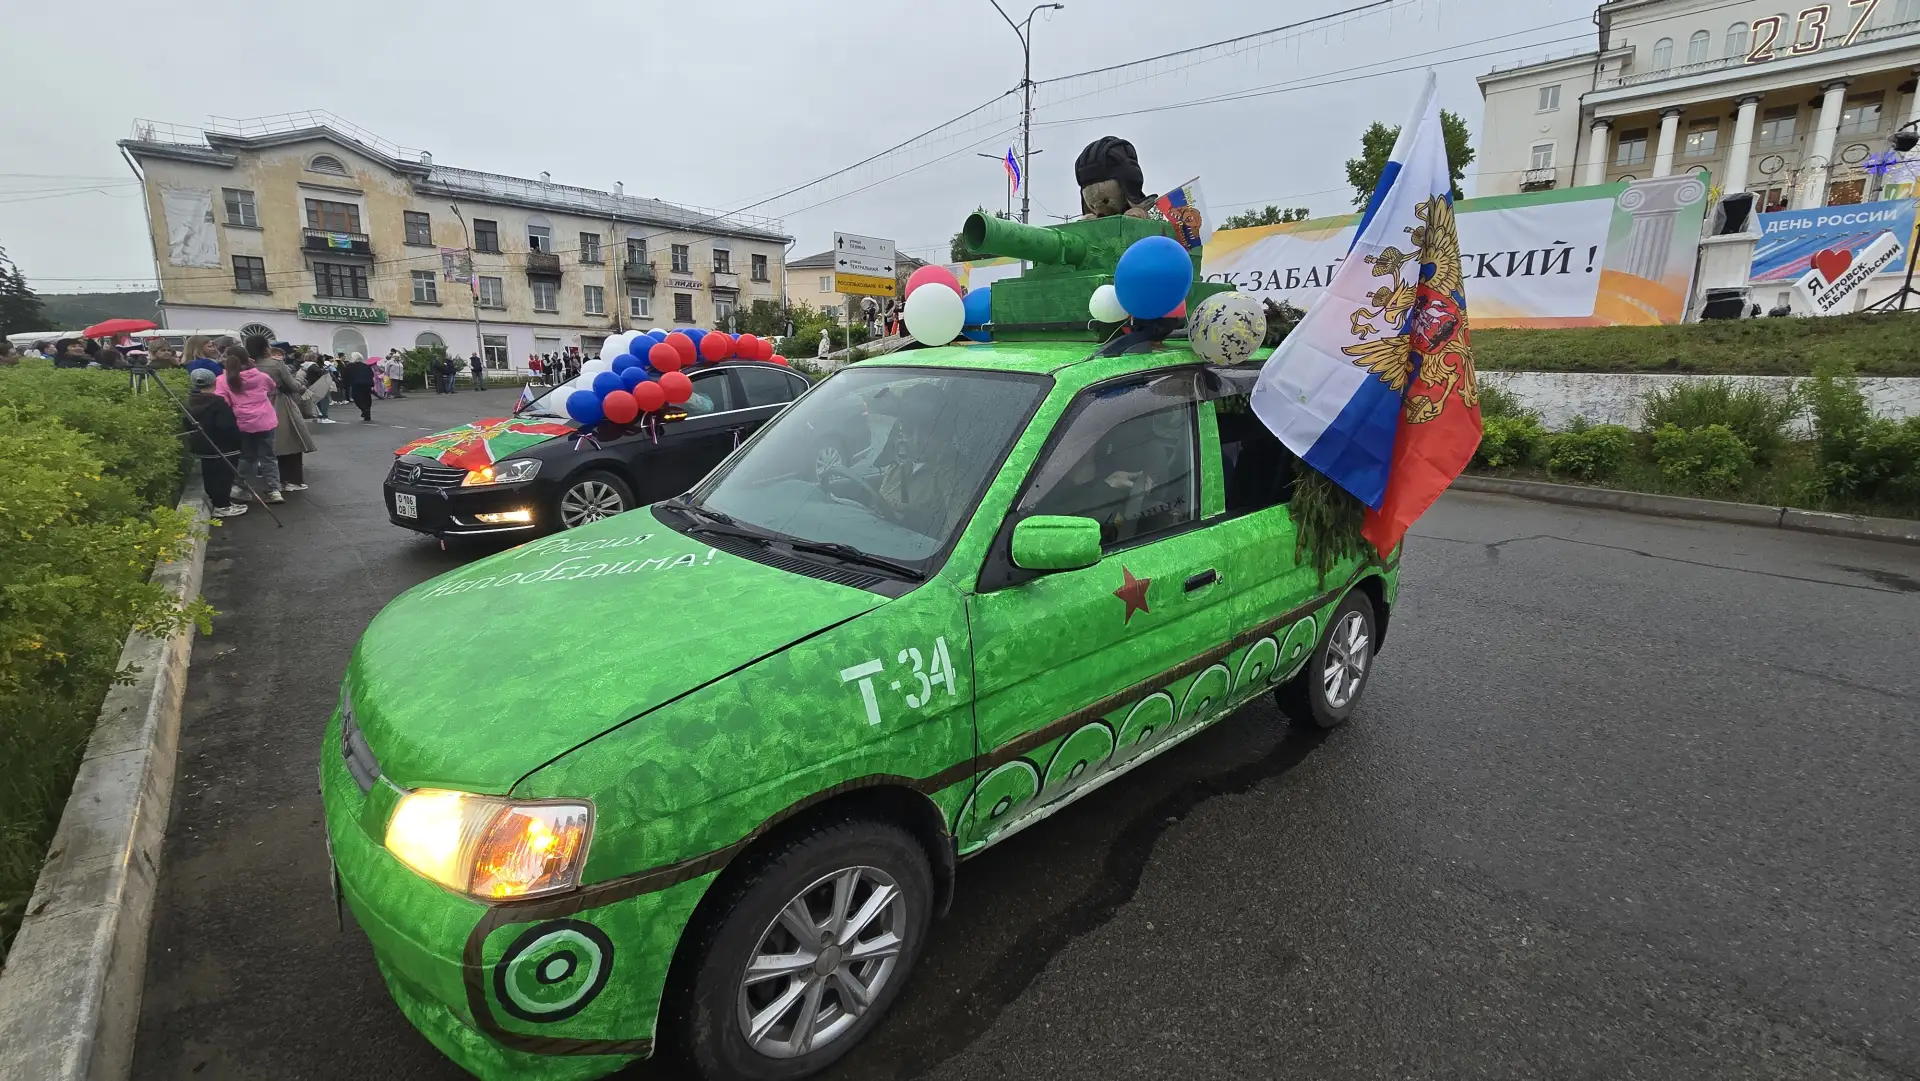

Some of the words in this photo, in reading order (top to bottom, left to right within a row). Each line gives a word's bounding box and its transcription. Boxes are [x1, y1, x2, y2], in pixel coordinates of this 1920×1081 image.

[1745, 0, 1881, 64] 237
[1765, 218, 1813, 233] ДЕНЬ
[1817, 209, 1898, 228] РОССИИ
[1808, 276, 1824, 296] Я
[1816, 261, 1868, 306] ПЕТРОВСК-
[1821, 243, 1901, 312] ЗАБАЙКАЛЬСКИЙ
[309, 305, 378, 318] ЛЕГЕНДА
[840, 636, 956, 726] Т-34
